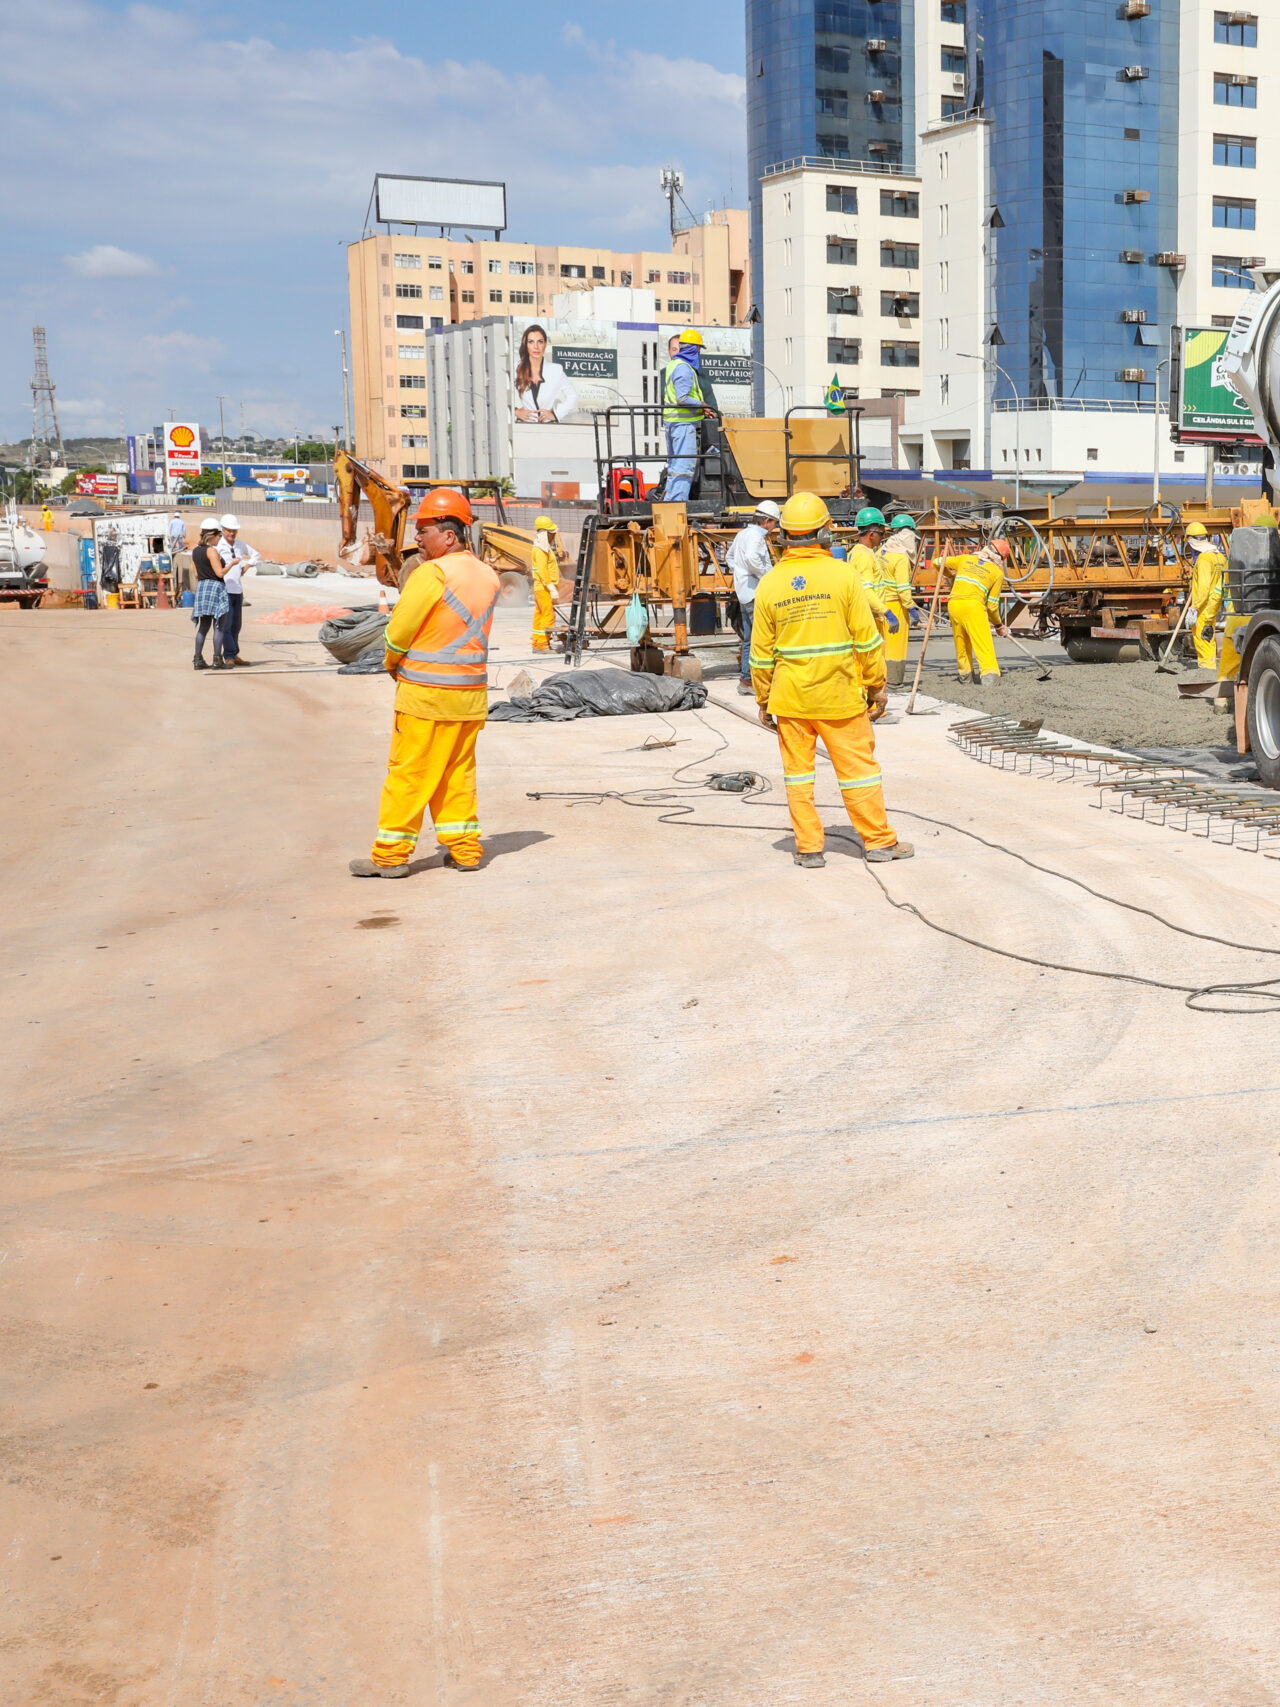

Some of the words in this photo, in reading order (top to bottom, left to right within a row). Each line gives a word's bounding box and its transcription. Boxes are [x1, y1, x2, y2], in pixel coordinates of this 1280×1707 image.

[557, 350, 614, 359] HARMONIZAÇÃO
[564, 362, 607, 371] FACIAL
[701, 359, 752, 367] IMPLANTES
[709, 370, 753, 378] DENTÁRIOS
[1192, 416, 1227, 424] CEILÂNDIA
[1227, 417, 1239, 425] SUL
[774, 599, 792, 608] TRIER
[792, 594, 831, 603] ENGENHARIA
